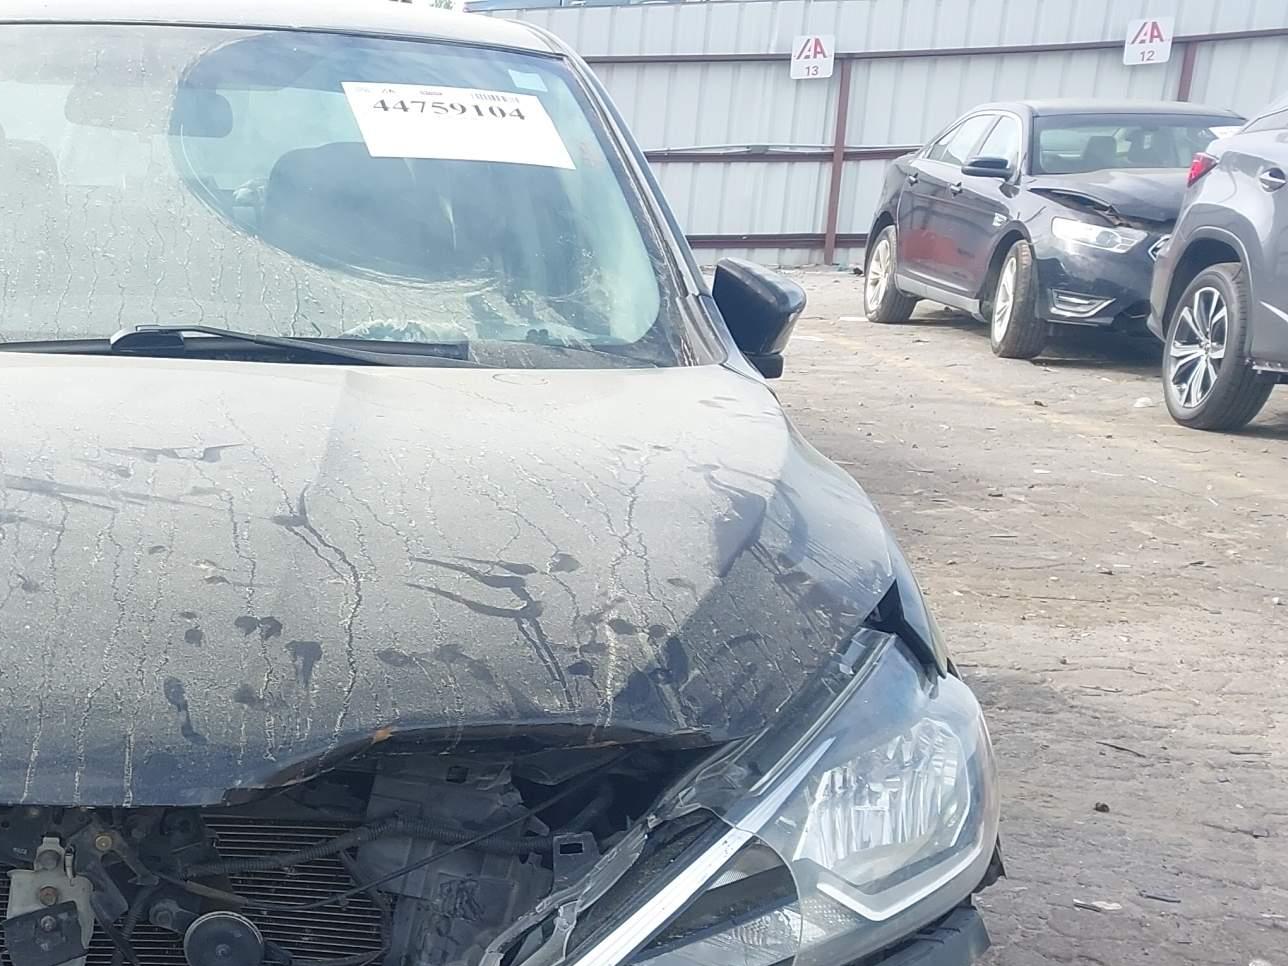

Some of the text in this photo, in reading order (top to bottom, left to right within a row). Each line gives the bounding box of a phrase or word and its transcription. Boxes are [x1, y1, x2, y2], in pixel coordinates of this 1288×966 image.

[1140, 50, 1155, 61] 12
[805, 65, 819, 76] 13
[372, 98, 526, 121] 44759104
